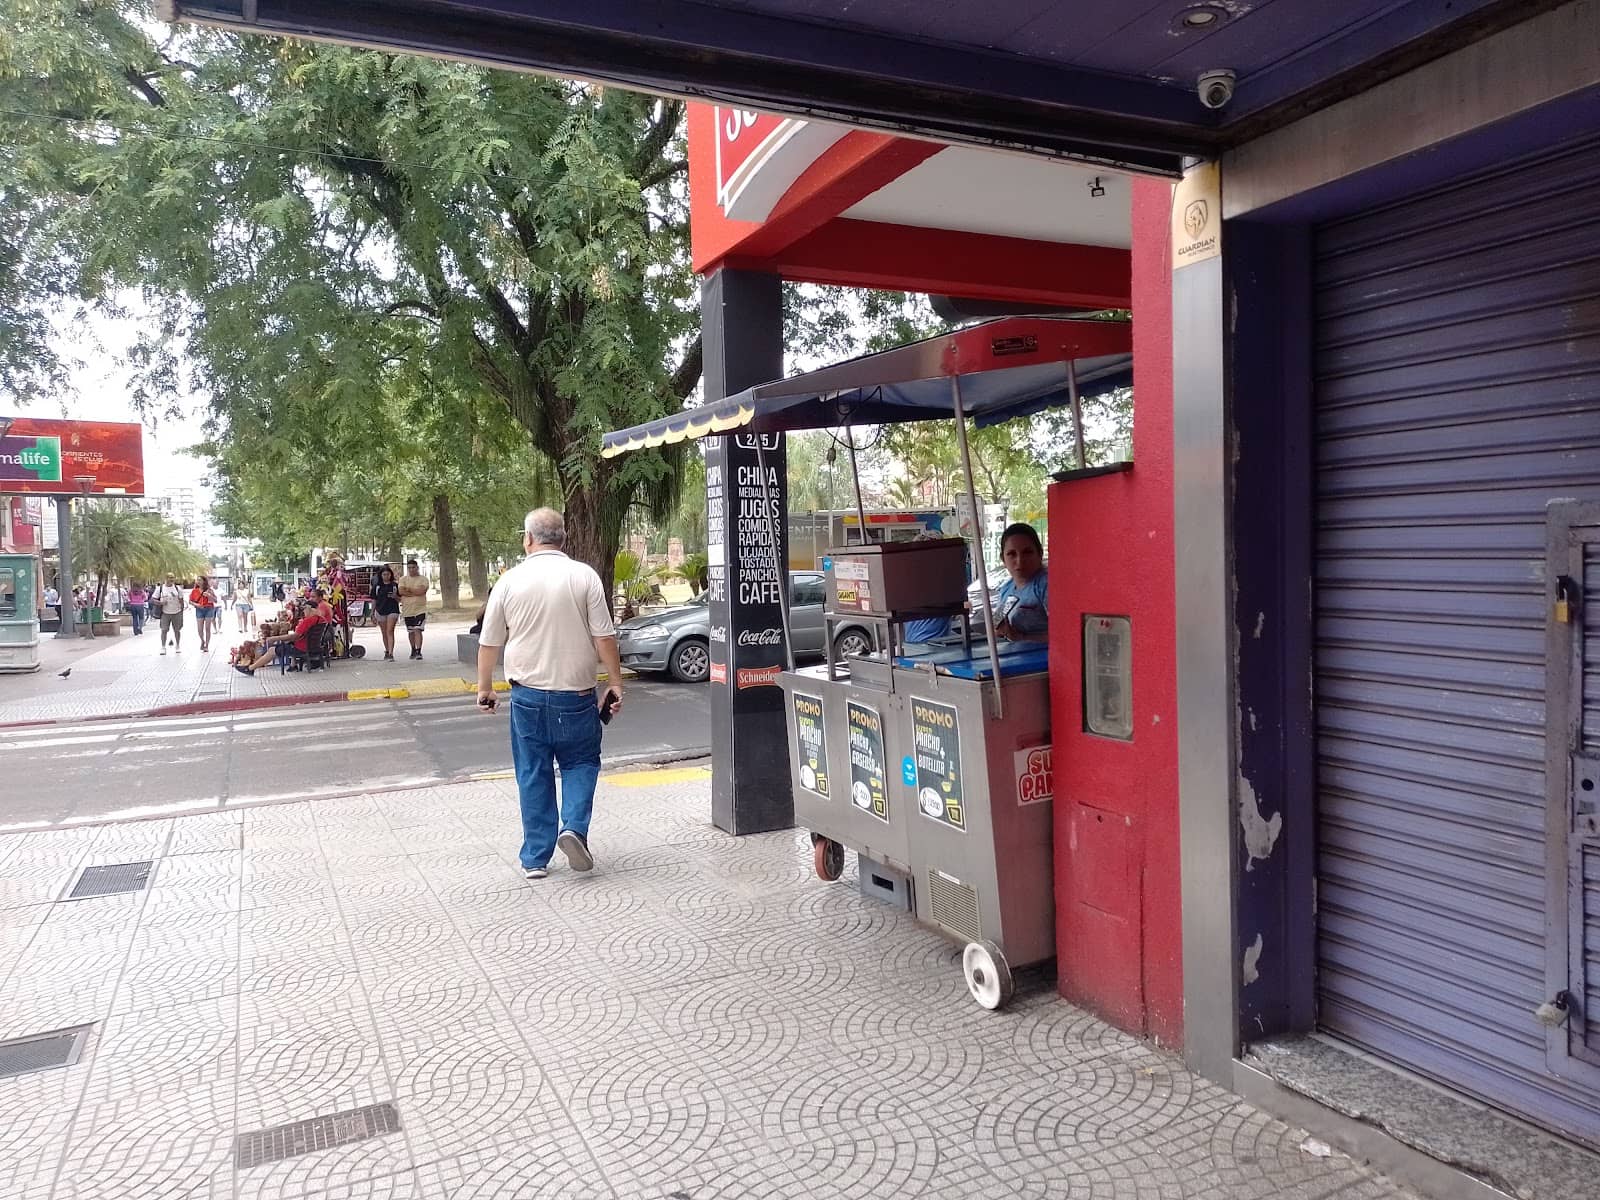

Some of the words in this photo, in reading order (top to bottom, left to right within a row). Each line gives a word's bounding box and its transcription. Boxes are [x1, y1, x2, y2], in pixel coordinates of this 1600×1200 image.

[1178, 236, 1216, 255] GUARDIAN
[739, 487, 780, 498] MEDIALAS
[738, 499, 780, 518] JUGOS
[739, 532, 780, 546] RAPIDAS
[740, 558, 777, 568] TOSTADO
[740, 582, 780, 604] CAFE
[738, 628, 783, 646] Coca-Cola
[740, 670, 776, 684] Schneide
[796, 699, 820, 716] PROMO
[850, 709, 878, 732] PROMO
[915, 705, 953, 729] PROMO
